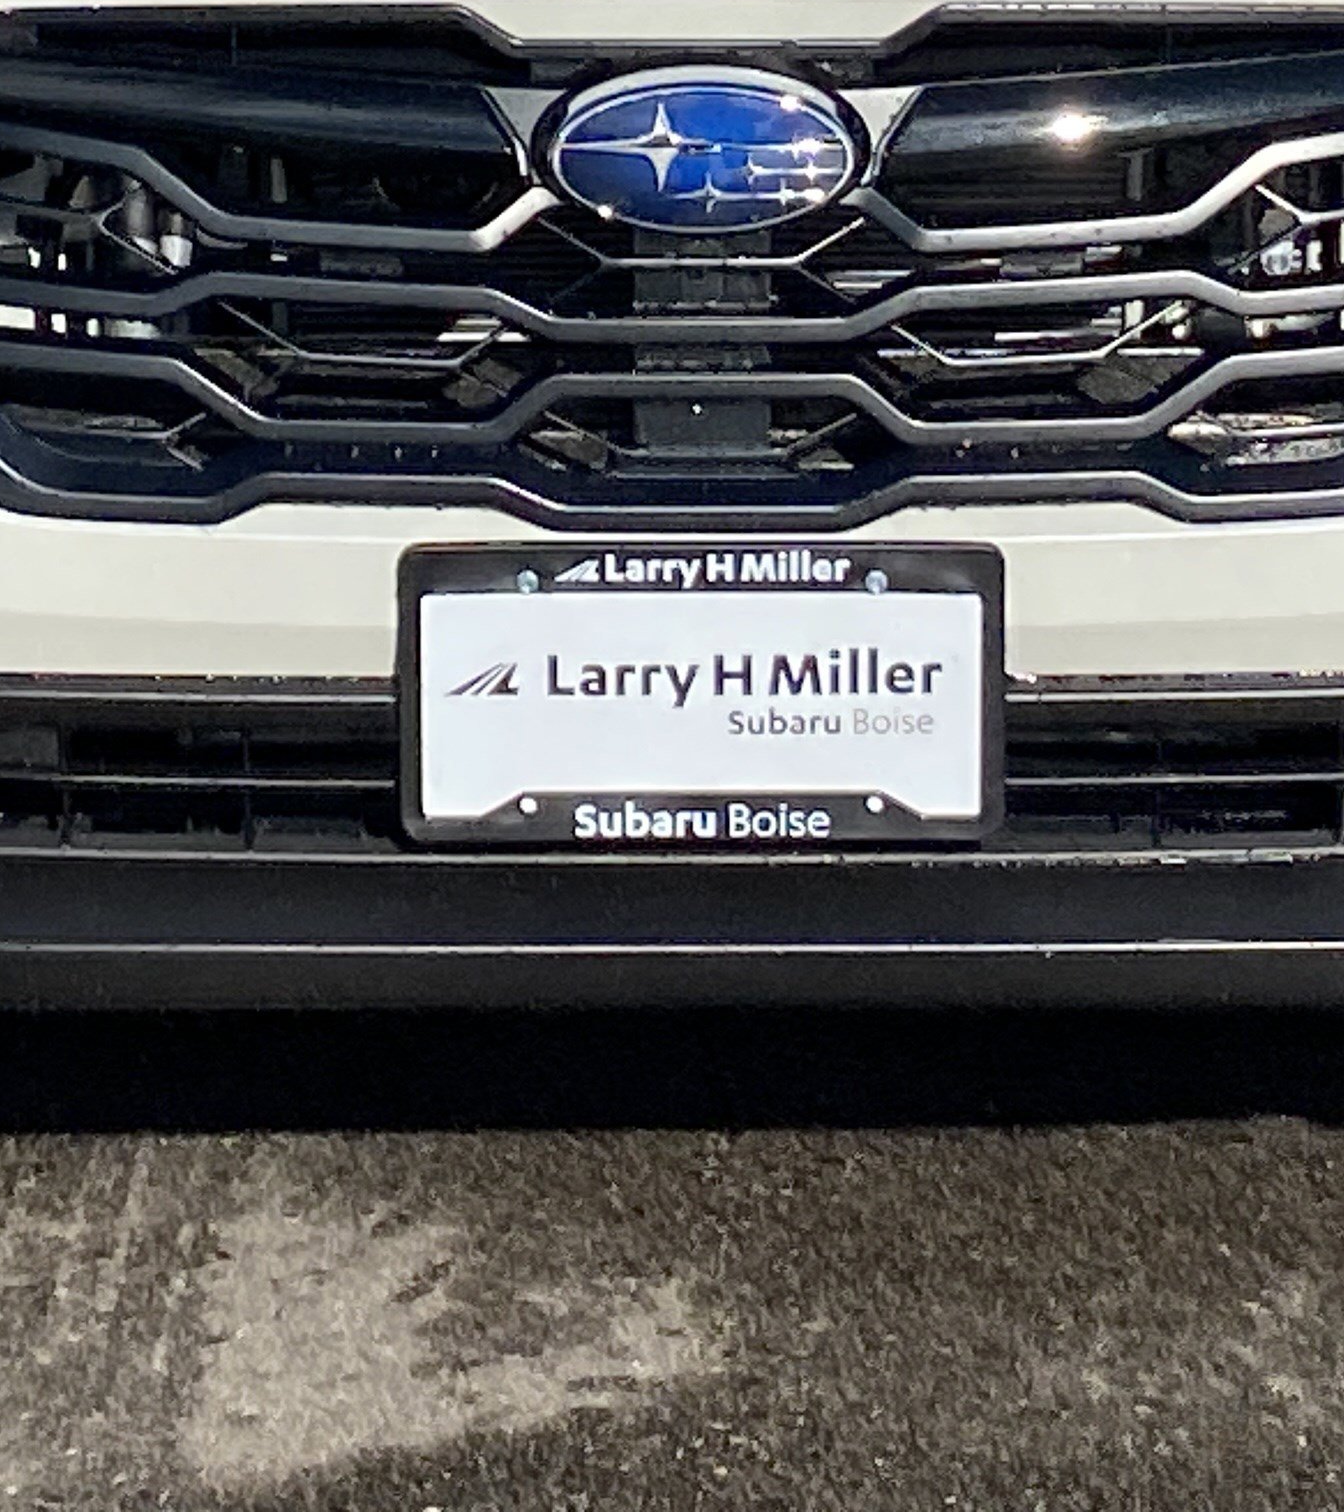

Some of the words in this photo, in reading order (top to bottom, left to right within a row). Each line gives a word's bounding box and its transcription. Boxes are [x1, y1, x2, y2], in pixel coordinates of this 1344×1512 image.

[604, 552, 701, 589] Larry
[706, 552, 735, 583] H
[740, 549, 852, 583] Miller
[547, 654, 700, 708] Larry
[713, 654, 753, 696] H
[768, 647, 943, 696] Miller
[728, 707, 842, 735] Subaru
[852, 707, 935, 735] Boise
[574, 802, 717, 839] Subaru
[728, 802, 831, 839] Boise
